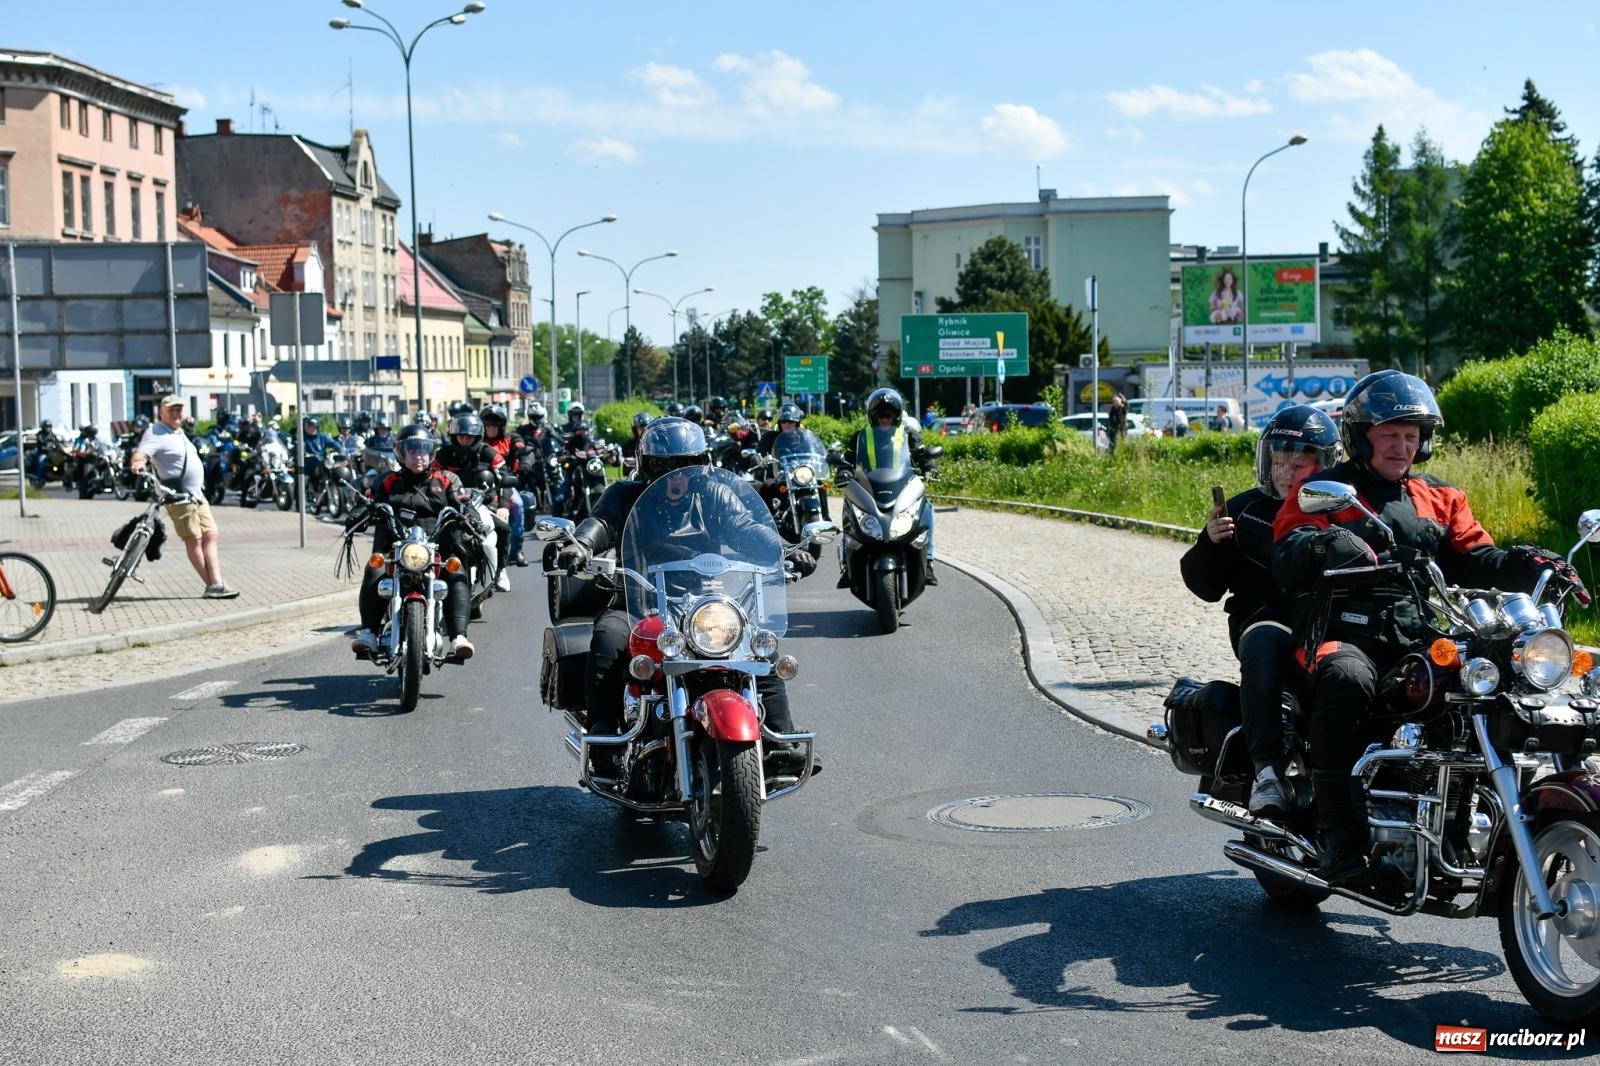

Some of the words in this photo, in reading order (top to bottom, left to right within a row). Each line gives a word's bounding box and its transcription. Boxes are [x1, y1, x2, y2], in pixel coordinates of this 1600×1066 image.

[938, 317, 968, 326] Rybnik
[938, 328, 970, 336] Gliwice
[938, 365, 966, 373] Opole
